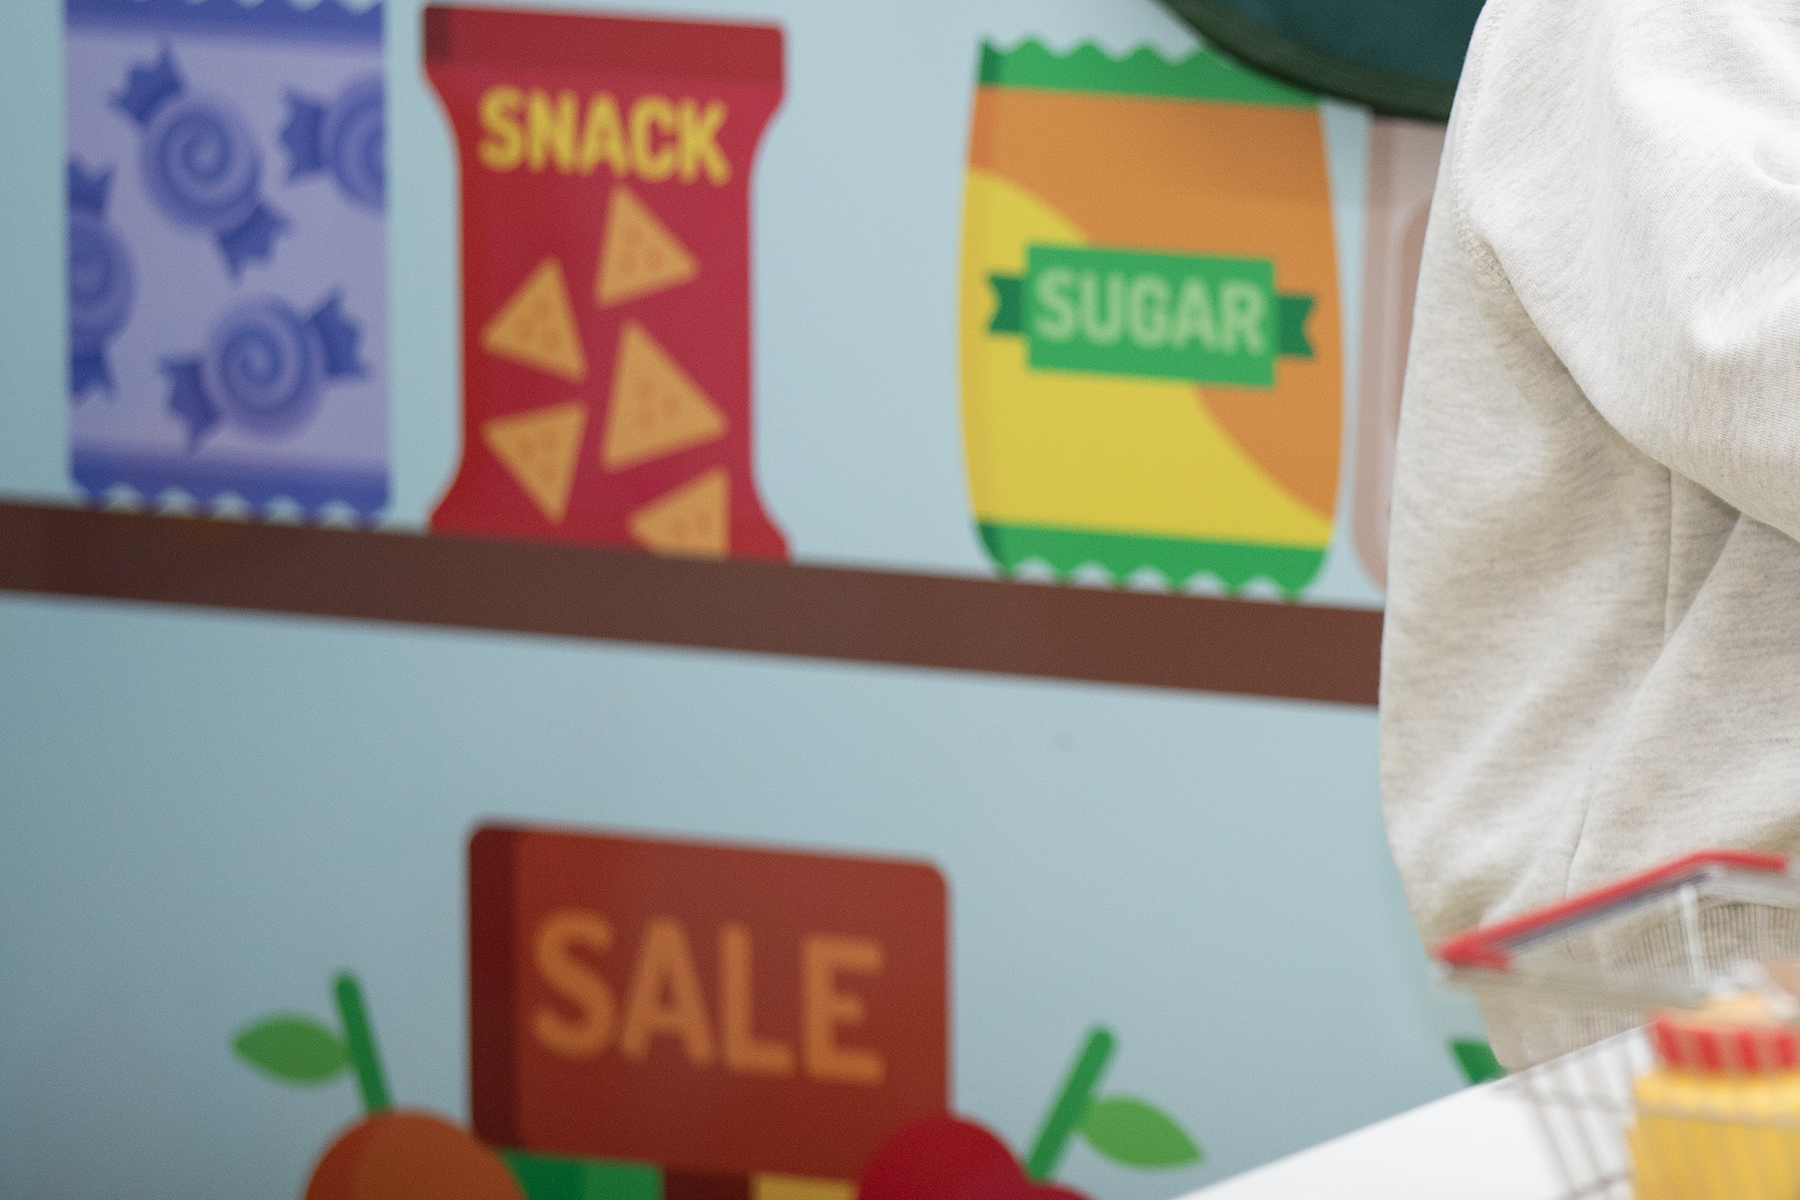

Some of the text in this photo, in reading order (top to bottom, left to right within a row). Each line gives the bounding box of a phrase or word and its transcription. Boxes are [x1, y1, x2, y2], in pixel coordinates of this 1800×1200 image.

[479, 86, 730, 186] SNACK
[1032, 266, 1268, 355] SUGAR
[531, 908, 885, 1084] SALE
